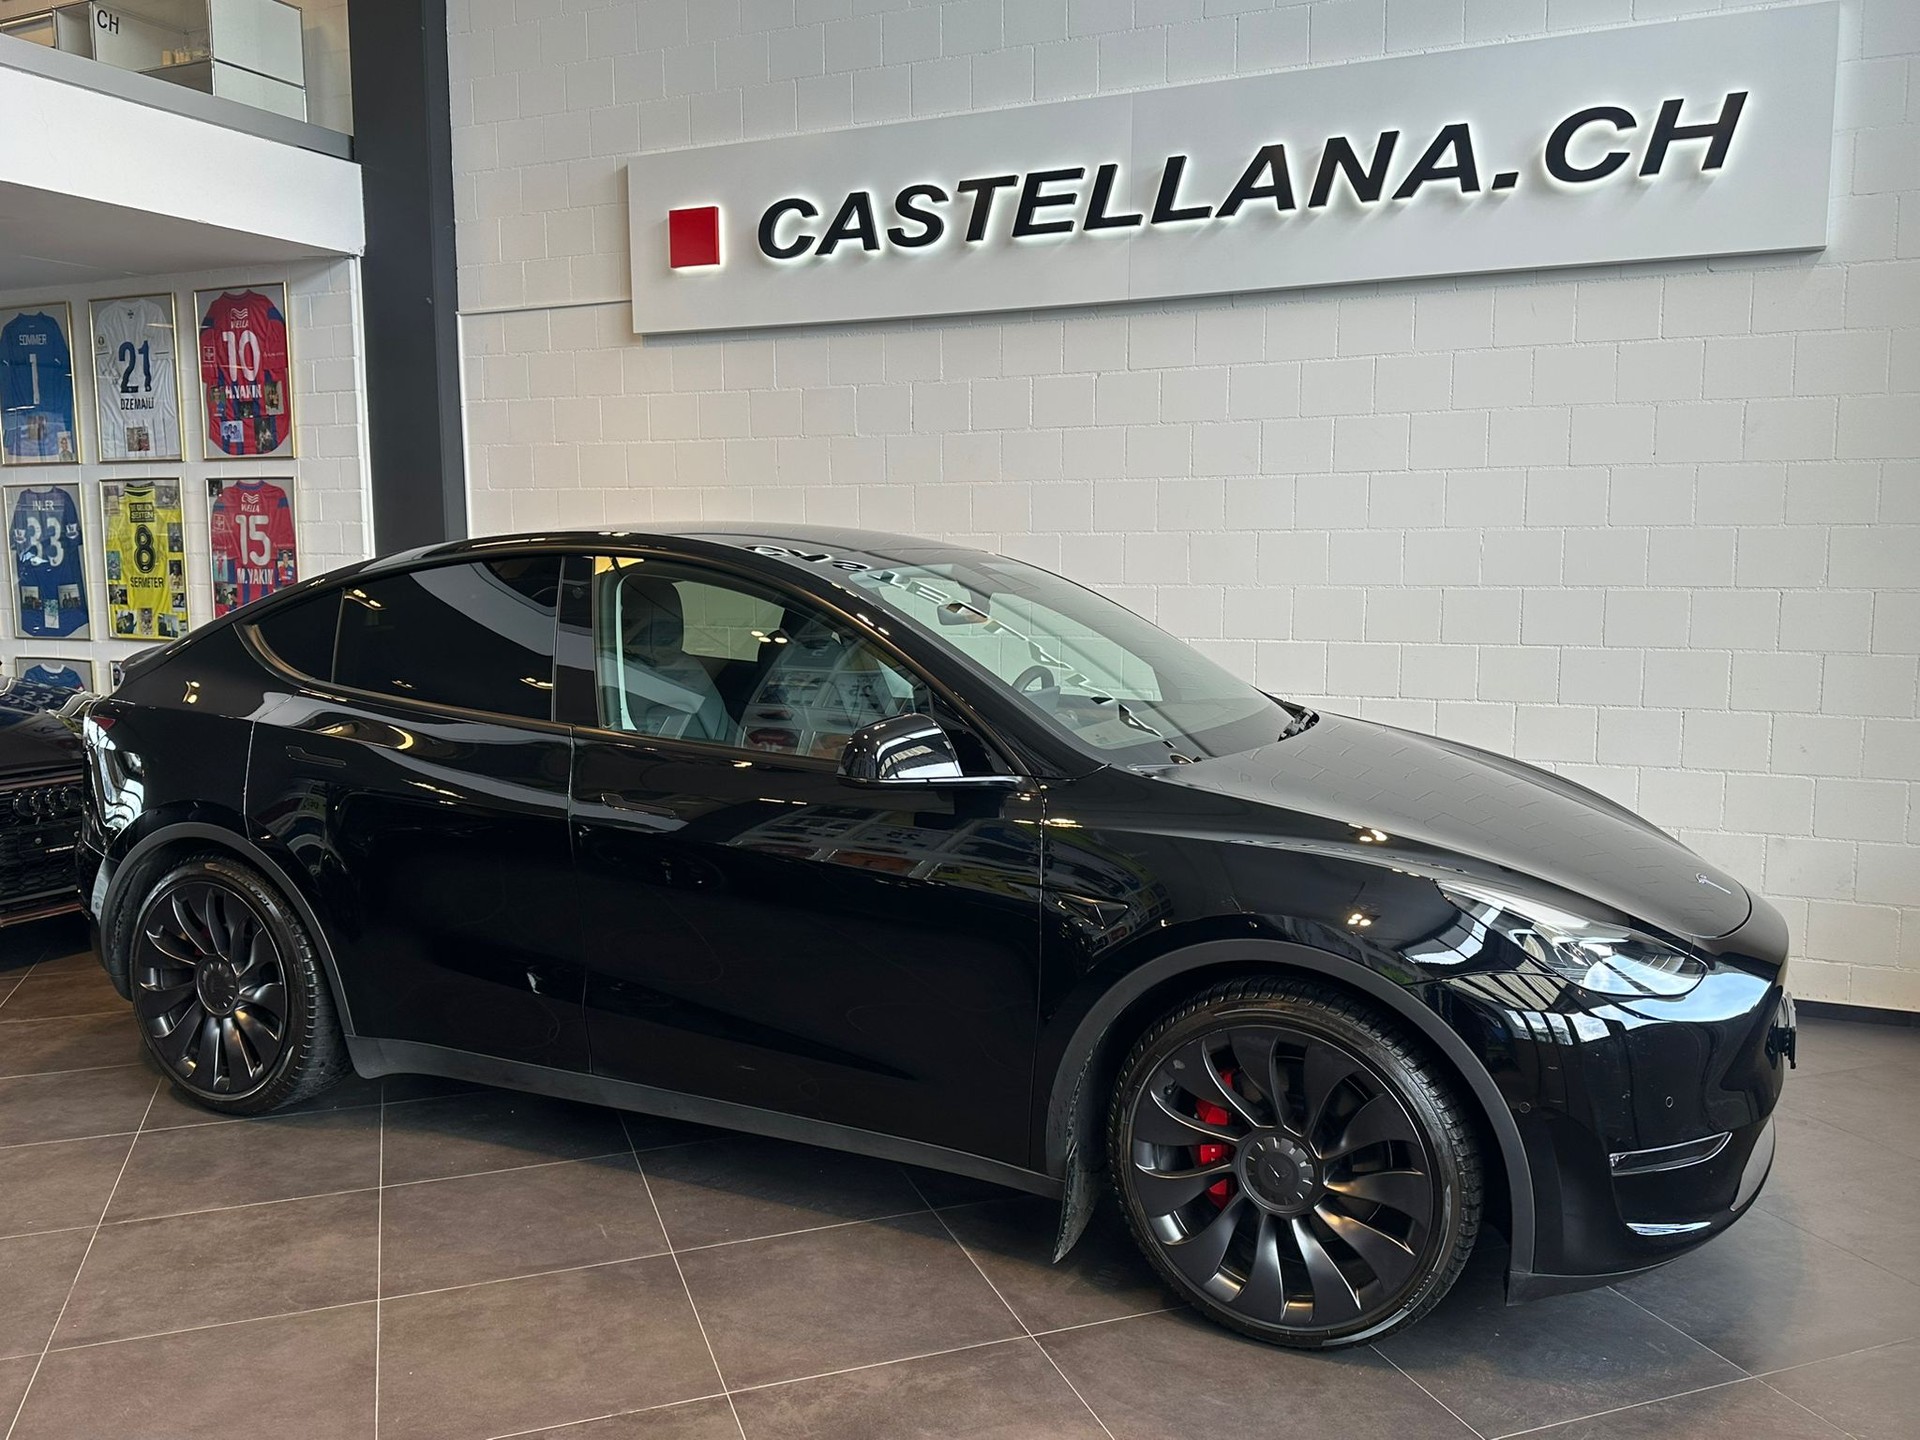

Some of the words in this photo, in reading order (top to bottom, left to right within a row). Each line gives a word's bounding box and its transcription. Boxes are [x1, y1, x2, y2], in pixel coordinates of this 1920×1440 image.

[96, 9, 120, 36] CH
[757, 91, 1749, 259] CASTELLANA.CH
[19, 333, 47, 346] SOMMER
[222, 330, 261, 382] 10
[29, 353, 40, 404] 1
[118, 340, 152, 394] 21
[32, 499, 55, 511] INLER
[27, 516, 64, 567] 33
[134, 523, 157, 574] 8
[235, 514, 272, 567] 15
[236, 567, 274, 585] M.YAKIN
